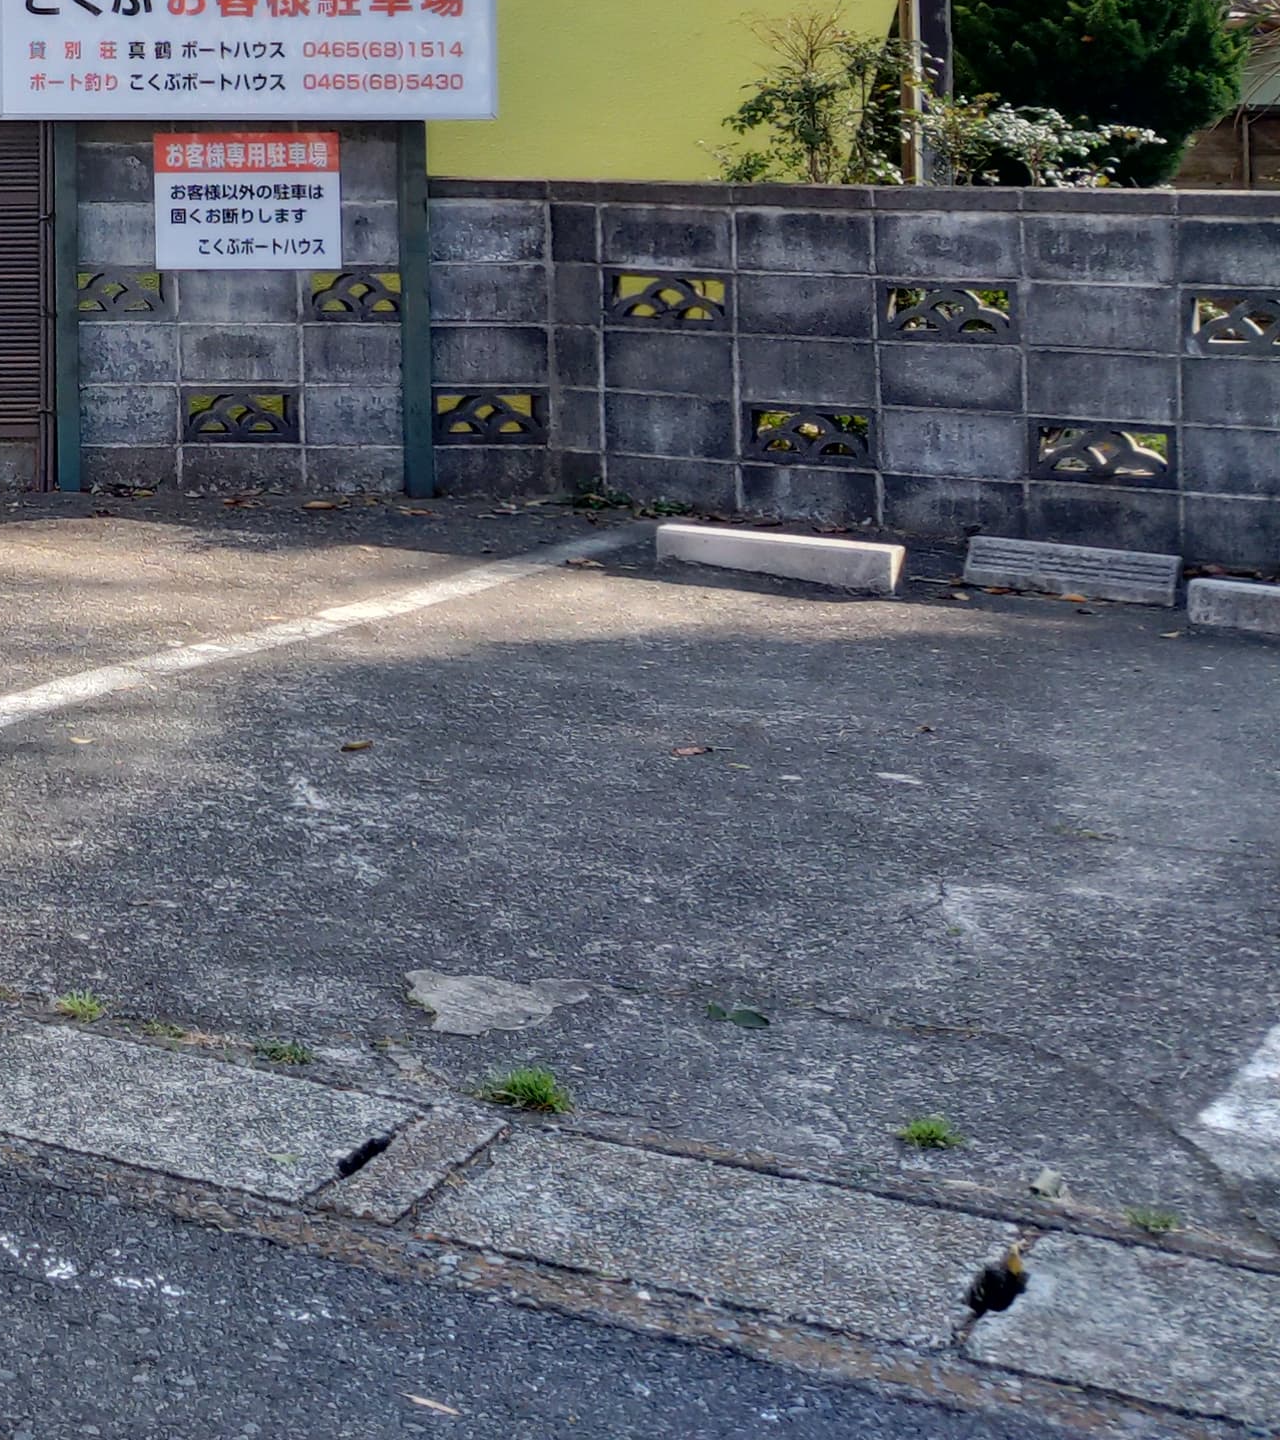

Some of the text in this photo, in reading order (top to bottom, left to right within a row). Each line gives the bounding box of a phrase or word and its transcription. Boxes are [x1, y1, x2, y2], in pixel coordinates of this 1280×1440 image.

[302, 40, 464, 60] 0465(68)1514
[29, 72, 464, 93] ボート釣り こくぶボートハウス 0465(68)5430
[165, 142, 328, 168] お客様専用駐車場
[170, 184, 325, 201] お客様以外の駐車は
[170, 208, 308, 225] 固くお断りします
[198, 238, 326, 255] こくぶボートハウス
